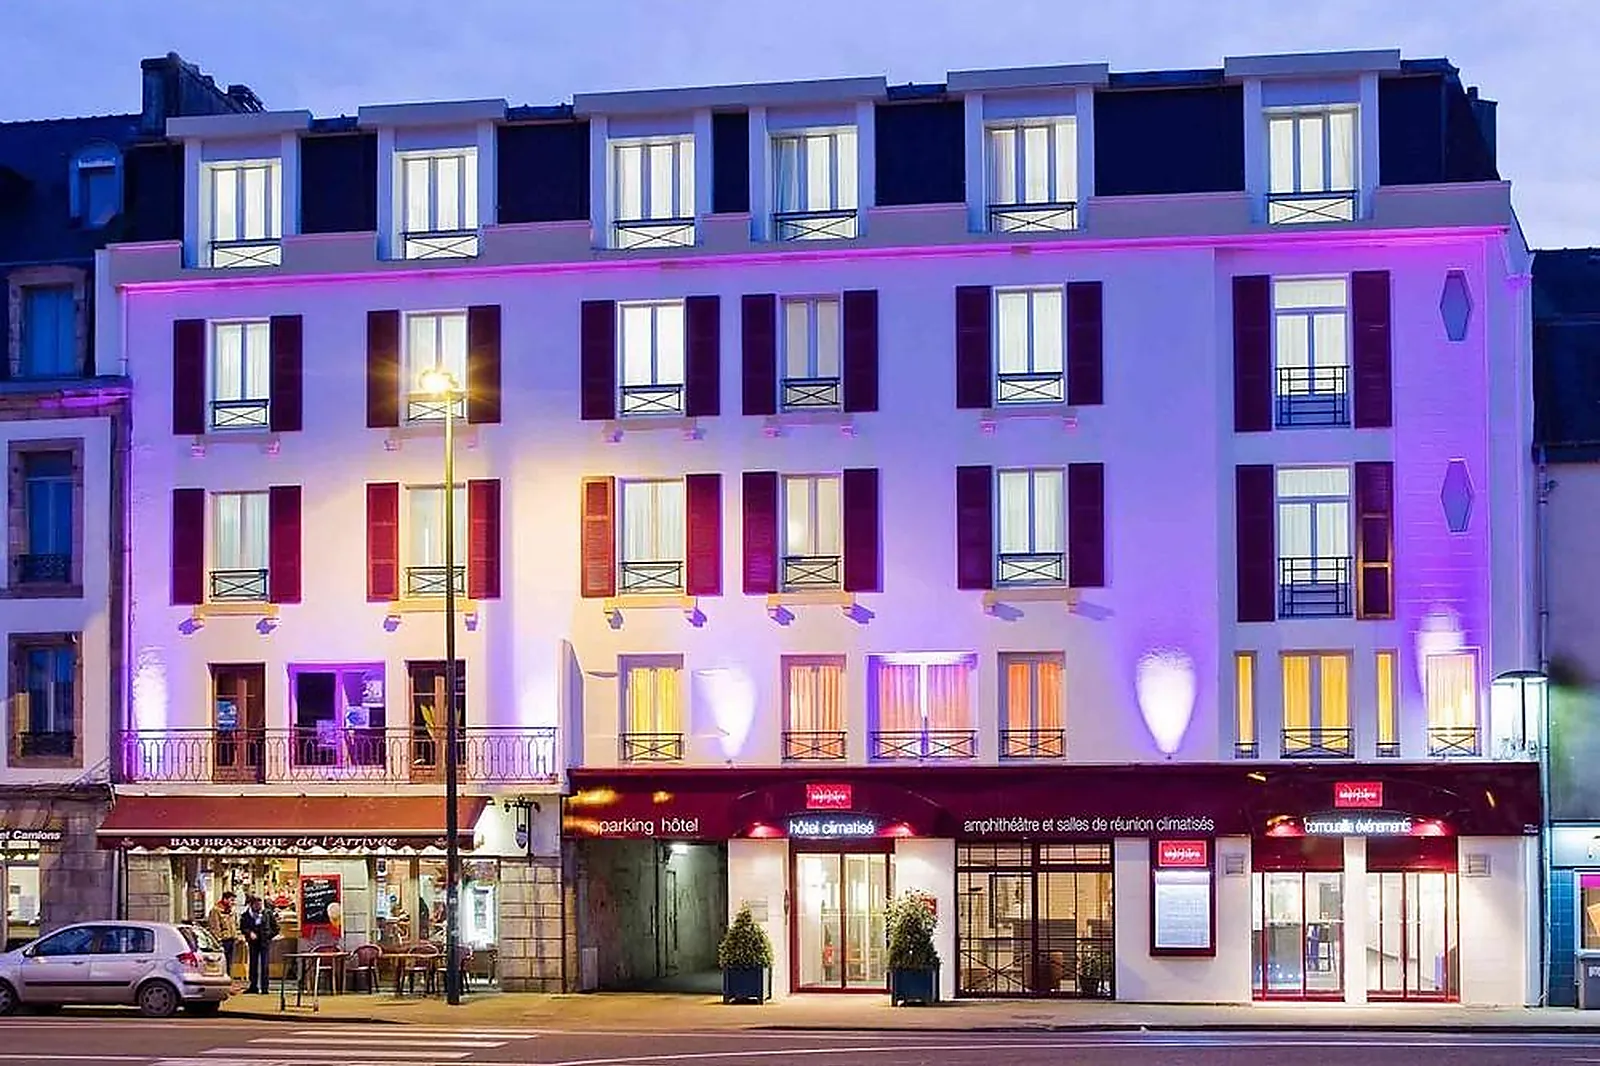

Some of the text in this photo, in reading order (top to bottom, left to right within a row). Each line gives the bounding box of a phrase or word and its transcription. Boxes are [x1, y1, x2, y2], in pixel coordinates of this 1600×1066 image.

[599, 817, 699, 836] parking hôtel
[790, 820, 875, 835] hôtel climatisé
[963, 816, 1215, 836] amphithéâtre et salles de réunion climatisés
[13, 830, 61, 840] Camions
[170, 837, 200, 847] BAR
[204, 837, 289, 847] BRASSERIE
[296, 835, 317, 847] de
